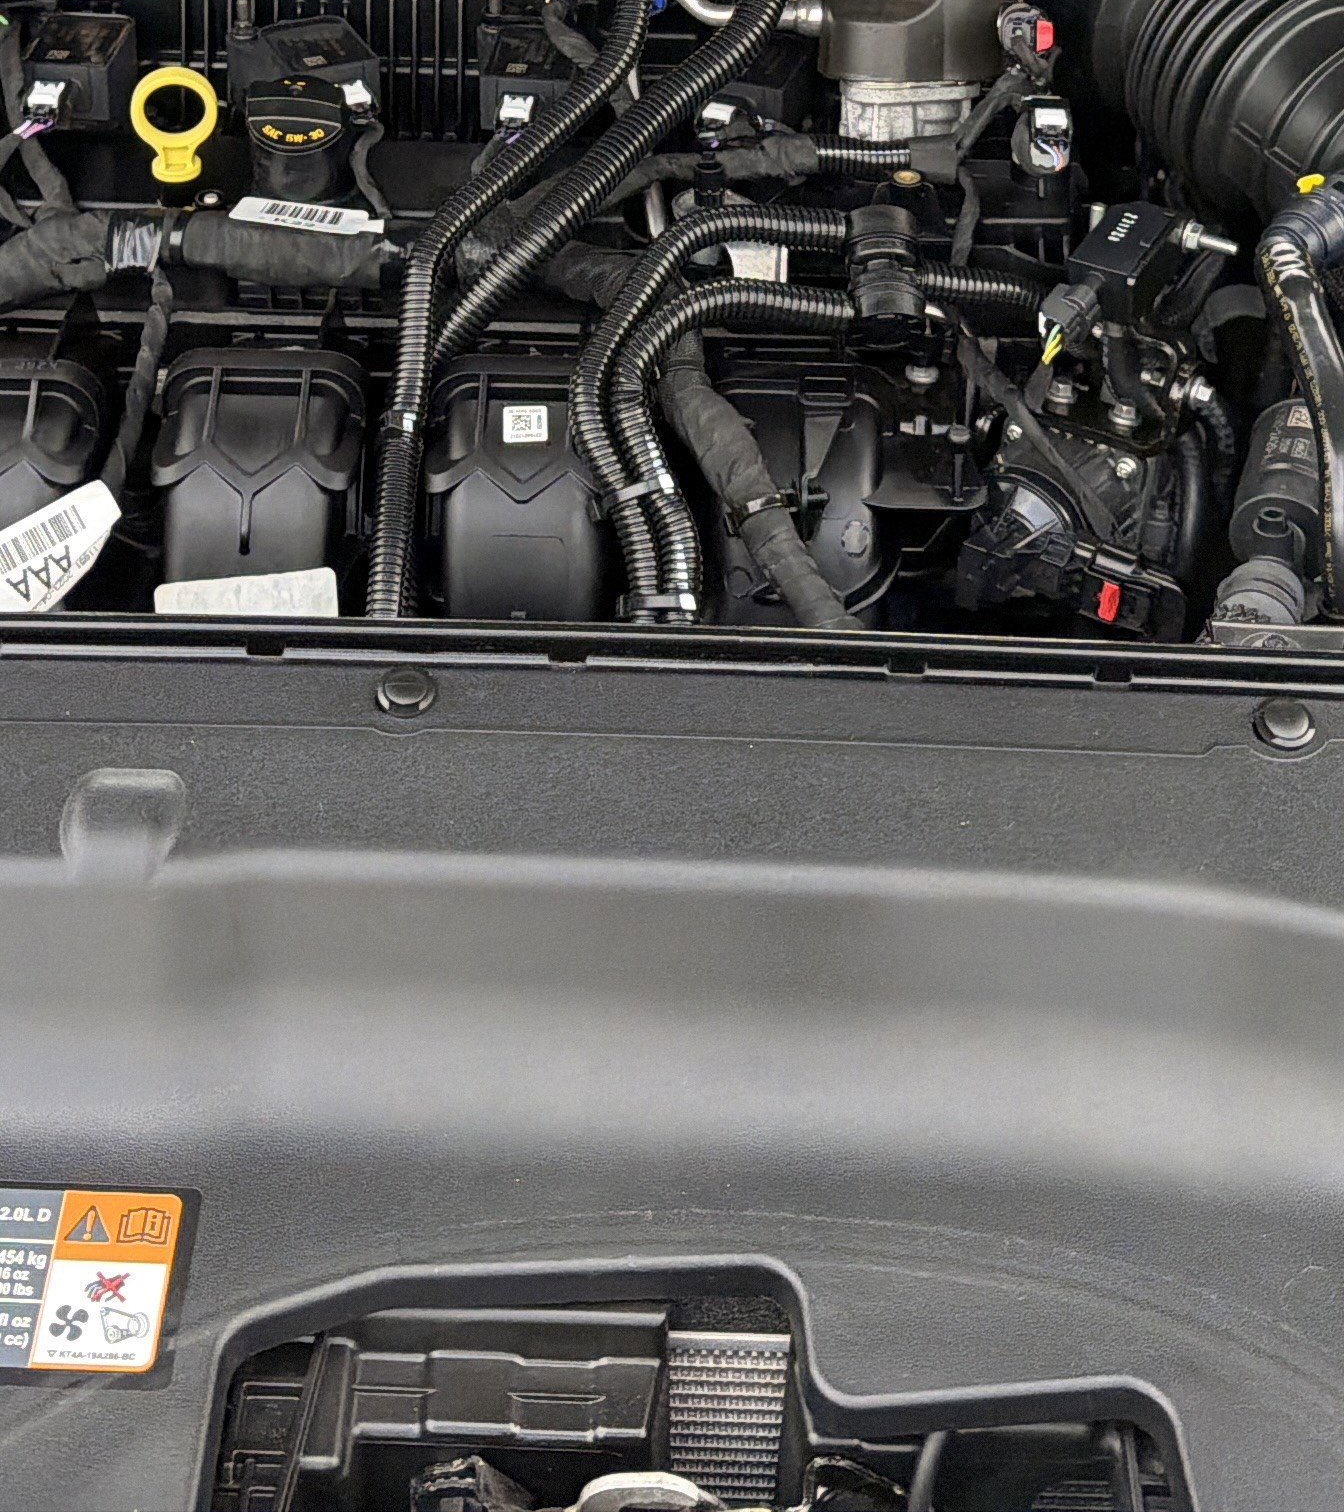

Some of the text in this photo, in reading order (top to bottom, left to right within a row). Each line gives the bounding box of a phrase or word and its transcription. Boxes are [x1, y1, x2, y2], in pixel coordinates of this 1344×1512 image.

[5, 546, 72, 603] AAA
[36, 1208, 51, 1222] D
[27, 1252, 47, 1270] kg
[12, 1270, 30, 1280] oz
[13, 1284, 34, 1296] lbs
[11, 1315, 32, 1327] oz
[4, 1331, 29, 1348] cc)
